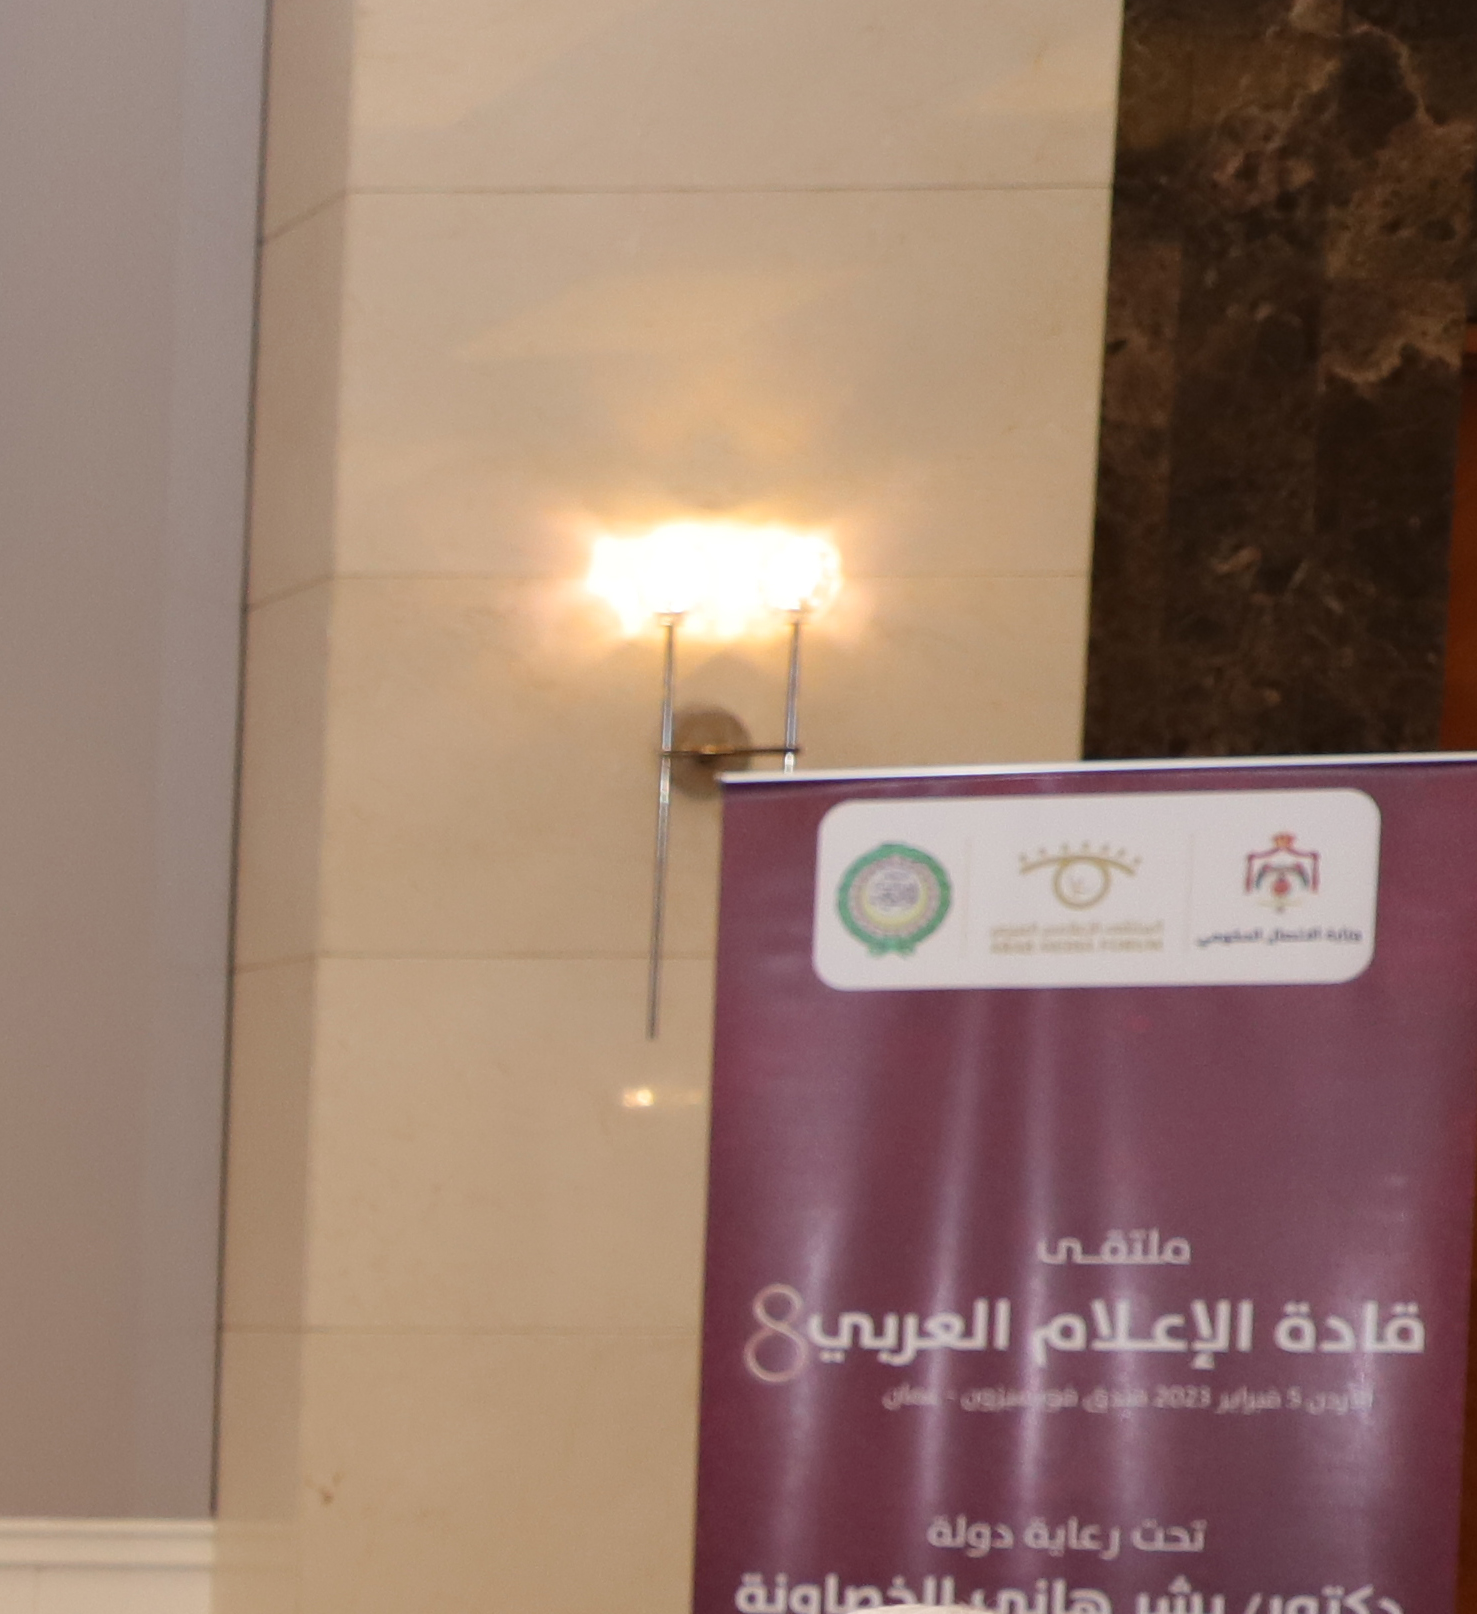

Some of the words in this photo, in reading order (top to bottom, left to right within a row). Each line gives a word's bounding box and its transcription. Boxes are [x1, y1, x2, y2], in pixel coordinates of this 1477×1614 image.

[744, 1283, 807, 1383] 8
[807, 1299, 1010, 1369] العربي
[1033, 1299, 1253, 1371] الإعلام
[1272, 1304, 1426, 1354] قادة
[1152, 1385, 1212, 1409] 2023
[927, 1516, 1014, 1558] دولة
[1023, 1517, 1123, 1560] رعاية
[1131, 1520, 1207, 1554] تحت
